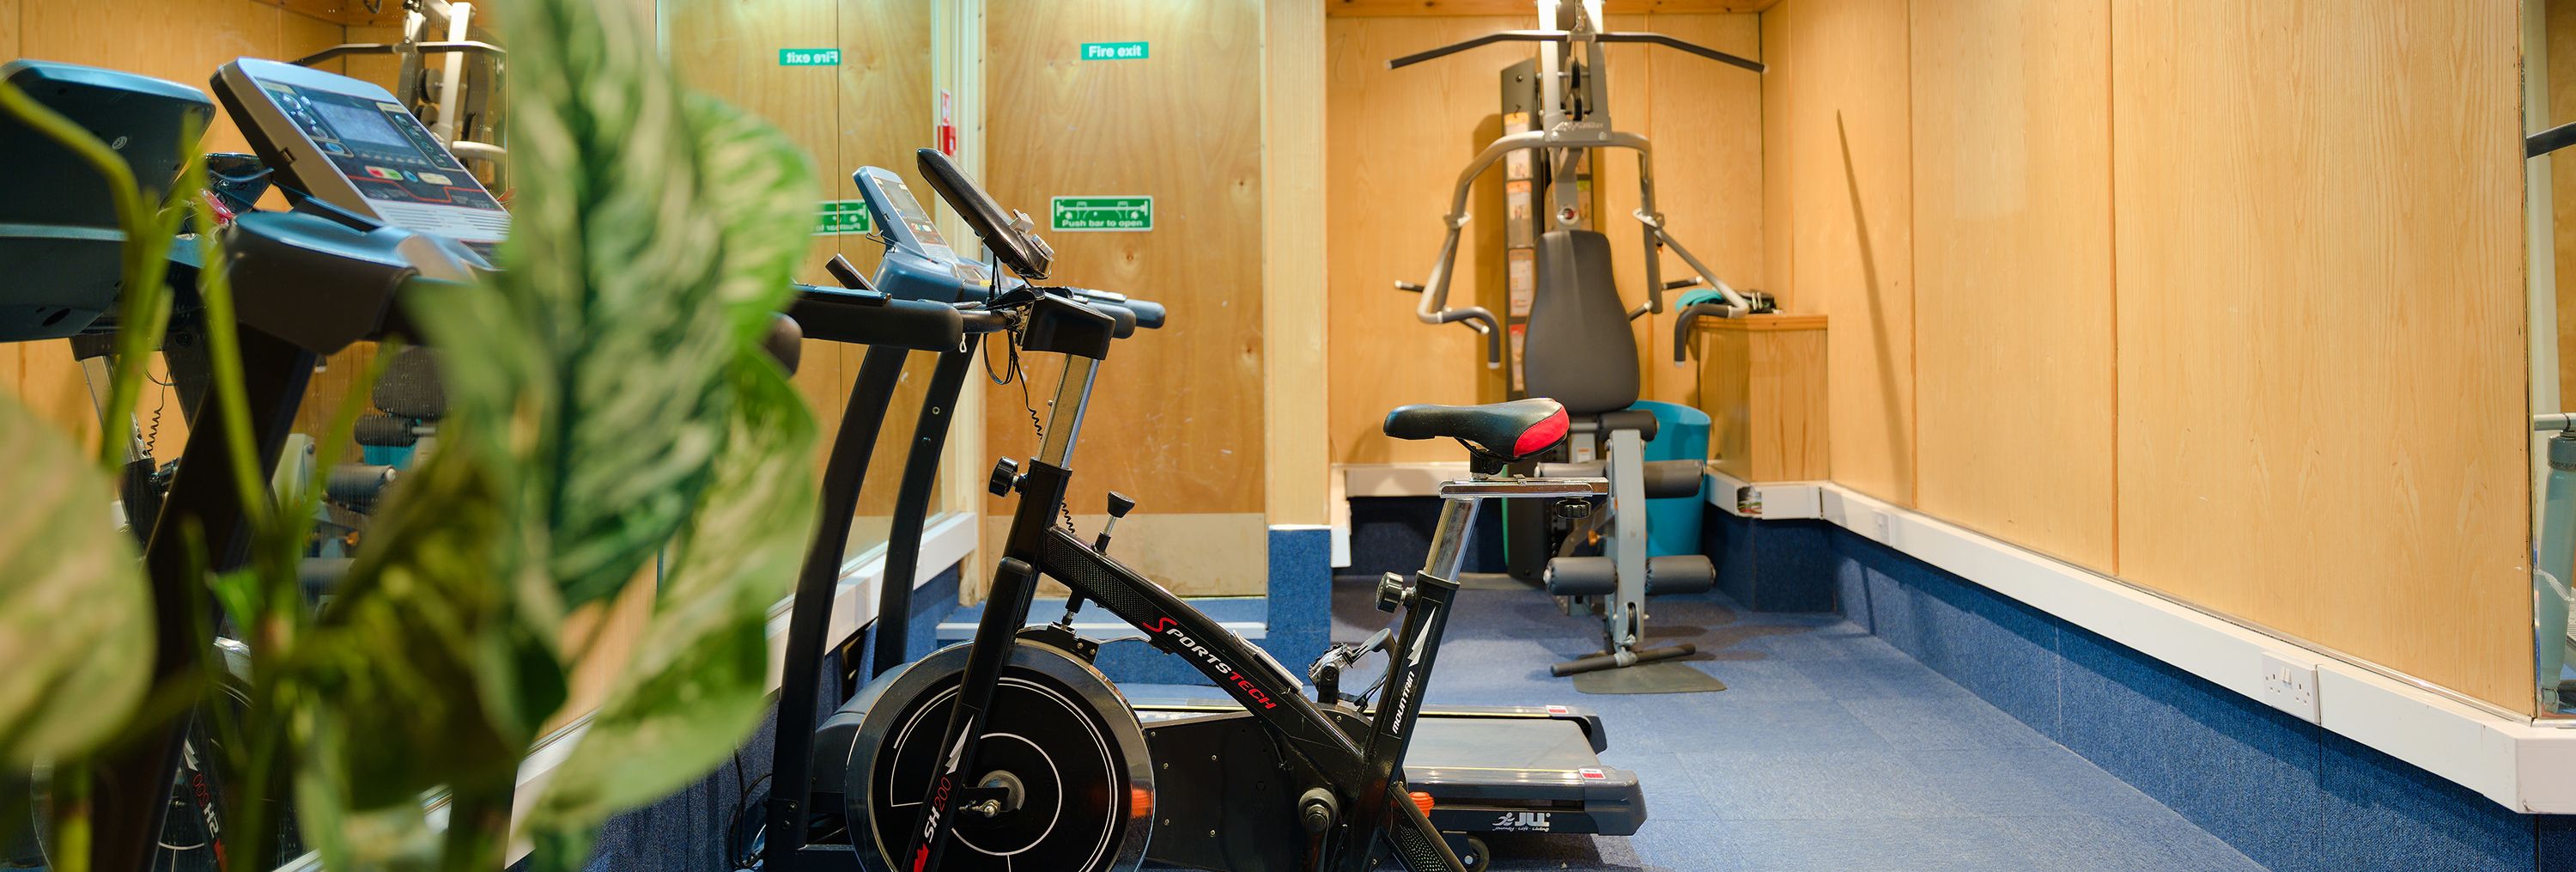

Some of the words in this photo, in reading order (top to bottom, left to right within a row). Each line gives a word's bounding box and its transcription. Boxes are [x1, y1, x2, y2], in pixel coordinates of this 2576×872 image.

[1088, 46, 1115, 58] Fire
[1117, 45, 1142, 58] exit
[1061, 219, 1086, 228] Push
[1088, 219, 1104, 228] bar
[1106, 219, 1117, 228] to
[1118, 220, 1143, 229] open
[1142, 617, 1278, 710] SPORTSTECH
[1392, 670, 1415, 735] MOUNTAIN
[924, 777, 951, 844] SH200
